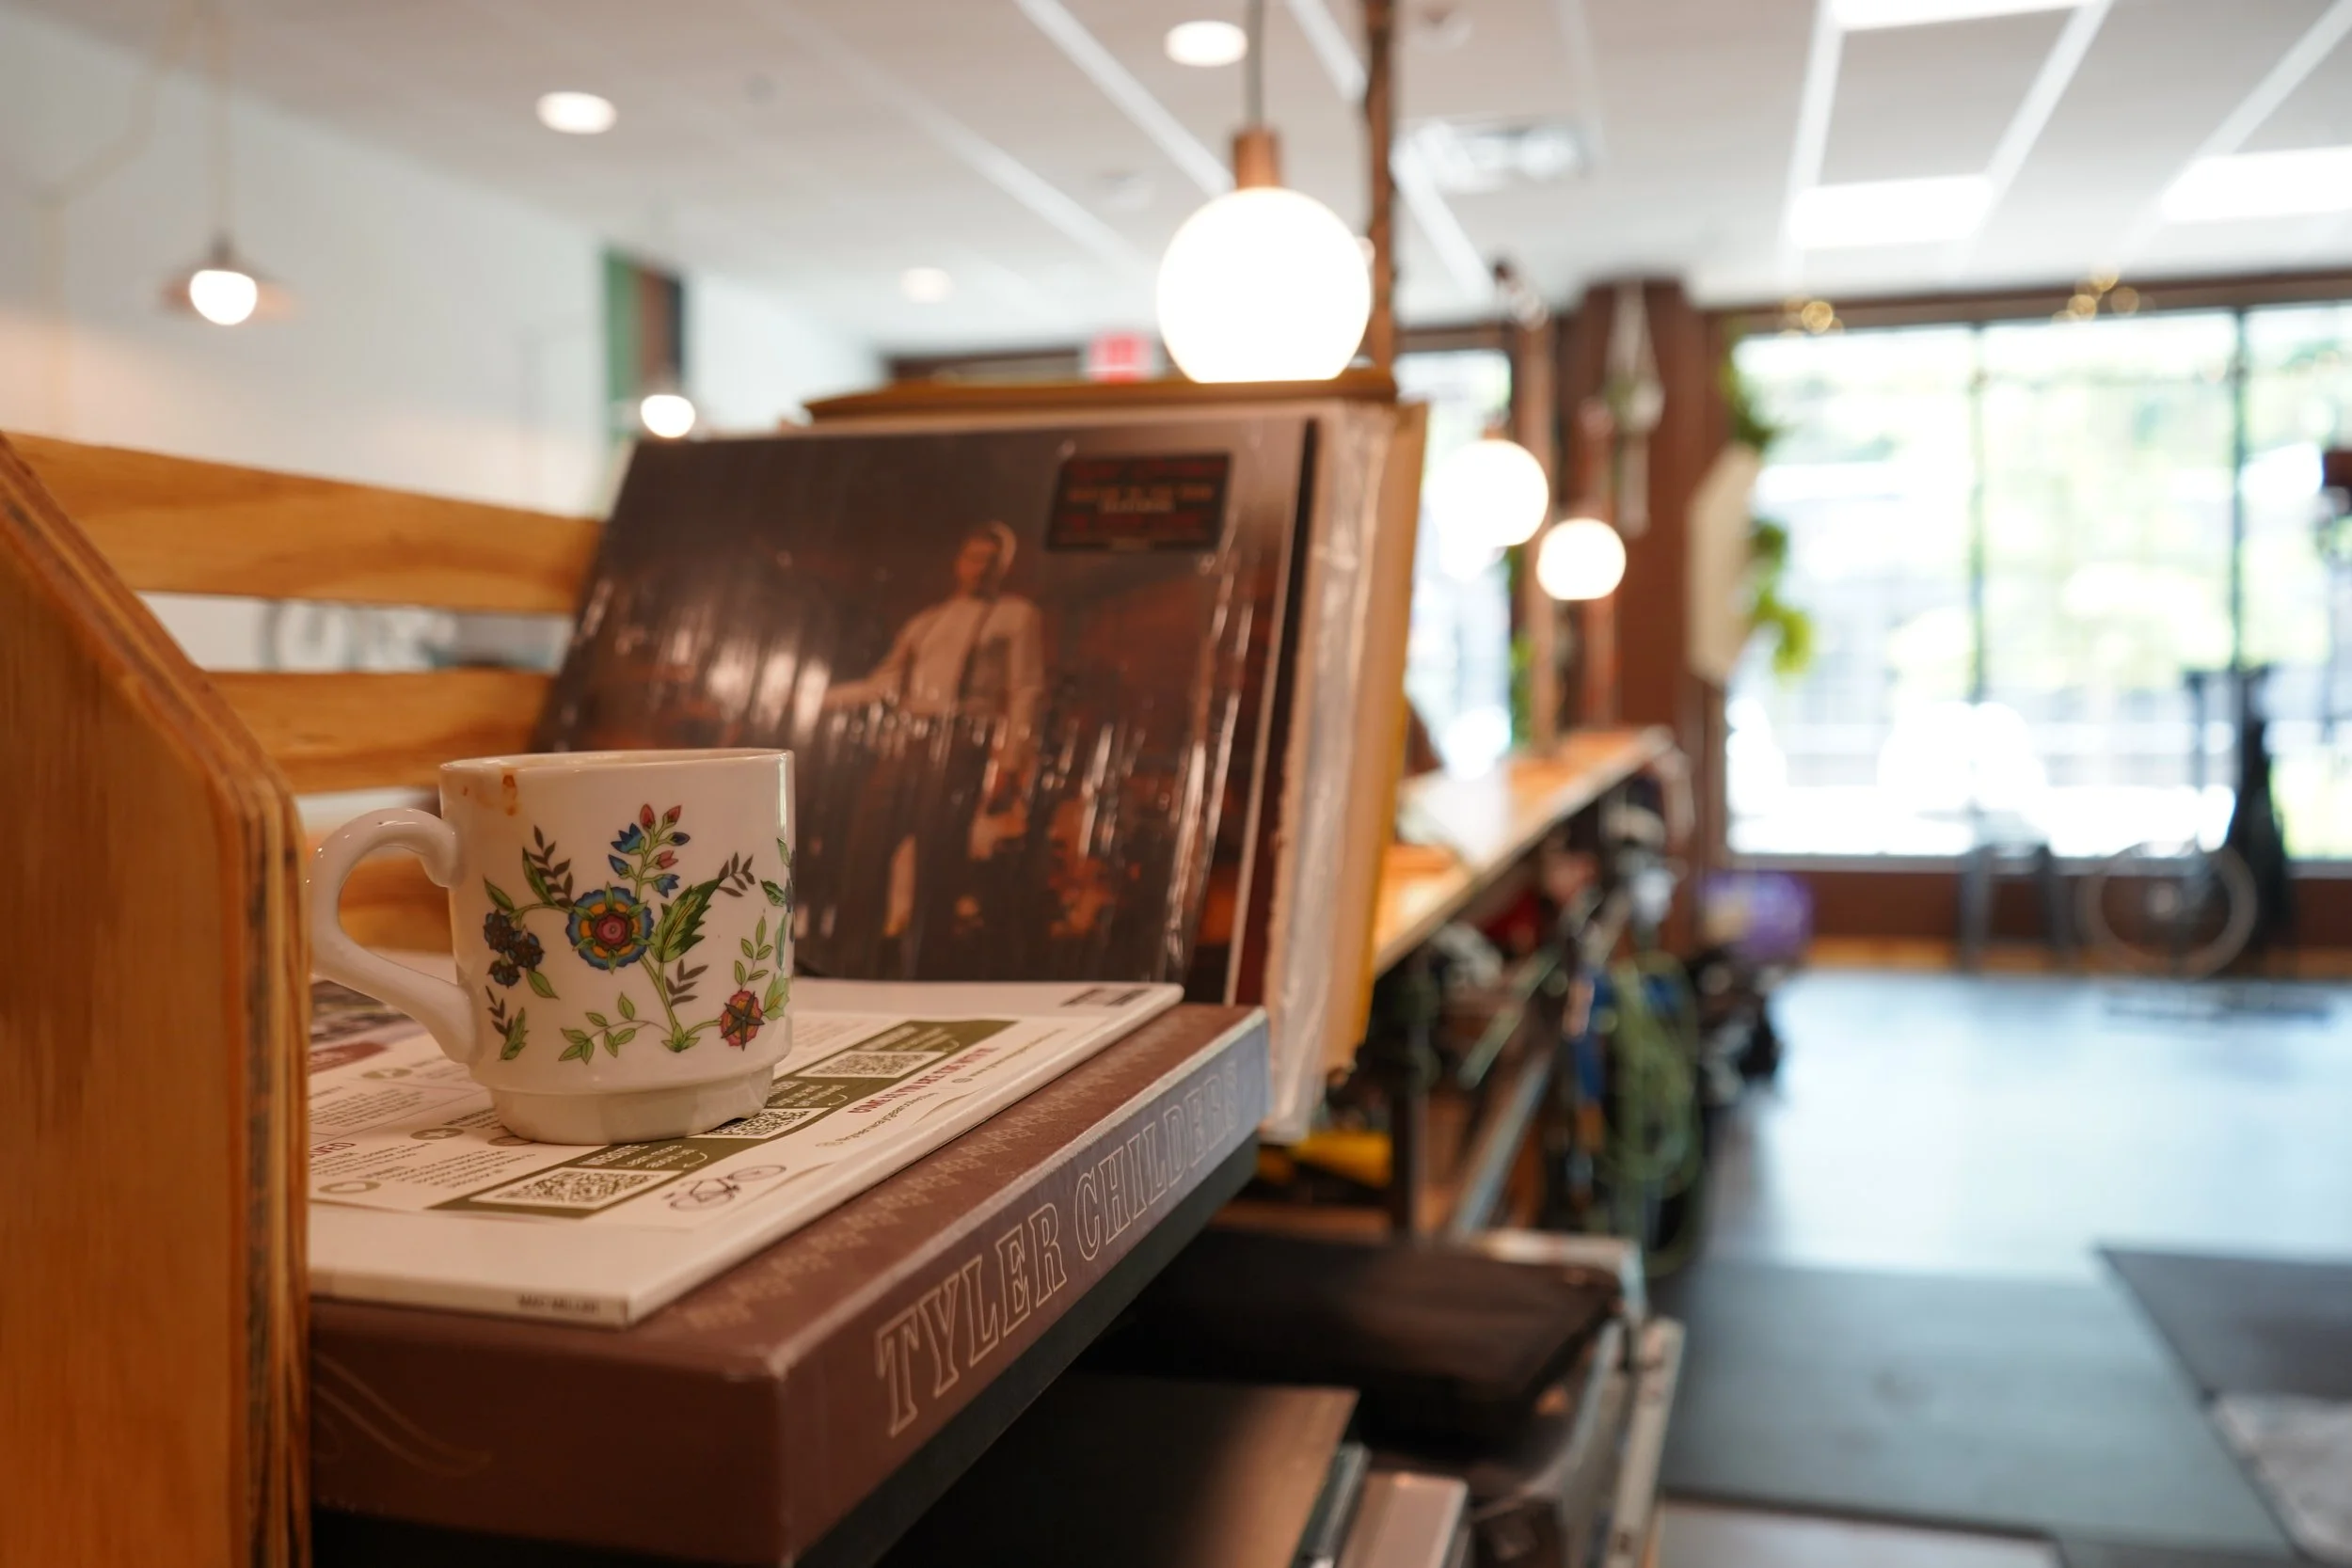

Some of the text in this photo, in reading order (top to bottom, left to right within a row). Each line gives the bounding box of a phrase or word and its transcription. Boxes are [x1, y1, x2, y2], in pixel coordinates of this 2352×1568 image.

[577, 1145, 649, 1165] WEBSITE
[875, 1059, 1238, 1437] TYLER CHILDERS
